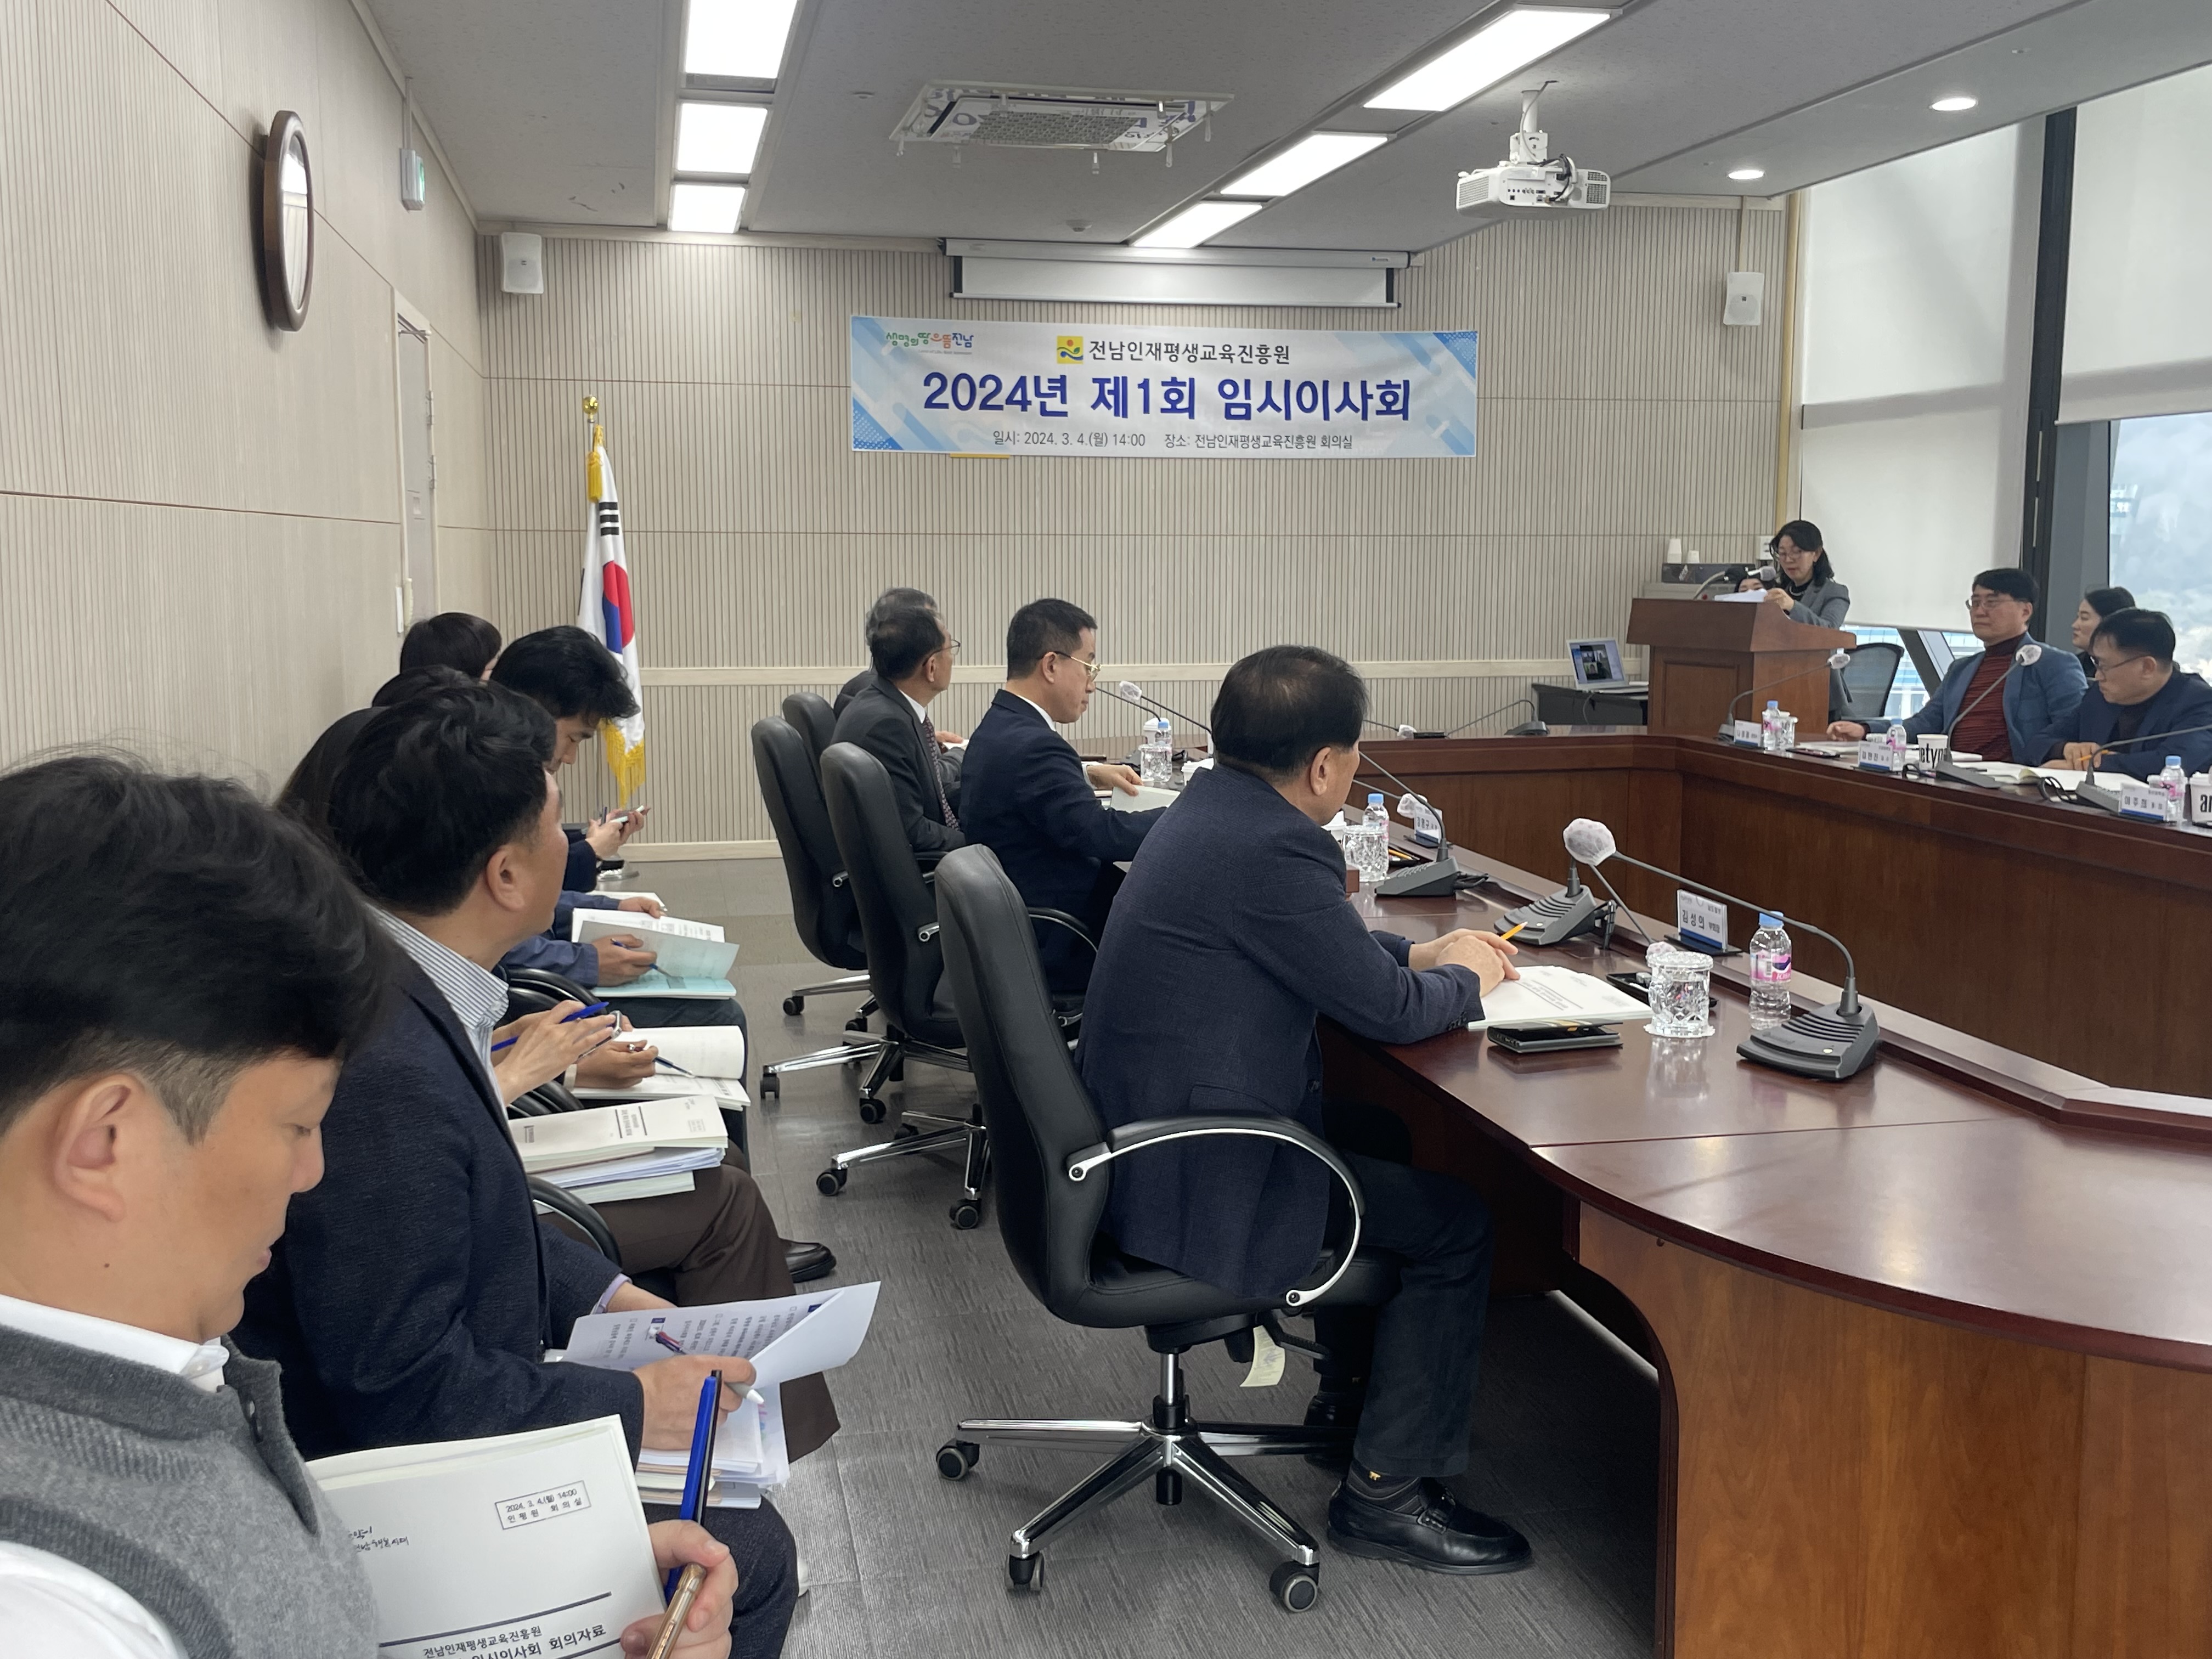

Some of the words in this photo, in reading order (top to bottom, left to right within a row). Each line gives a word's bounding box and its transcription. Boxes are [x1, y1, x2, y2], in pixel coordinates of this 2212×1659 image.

[1088, 341, 1290, 365] 전남인재평생교육진흥원
[923, 371, 1069, 417] 2024년
[1090, 375, 1195, 419] 제1회
[1217, 379, 1410, 421] 임시이사회
[993, 430, 1020, 445] 일시:
[1024, 432, 1058, 445] 2024.
[1062, 432, 1073, 445] 3.
[1113, 433, 1146, 447] 14:00
[1164, 434, 1190, 449] 장소:
[1194, 434, 1316, 449] 전남인재평생교육진흥원
[1320, 435, 1353, 449] 회의실
[506, 1502, 526, 1513] 2024.
[557, 1488, 577, 1499] 14:00
[424, 1626, 543, 1658] 전남인재평생교육진흥원
[549, 1624, 607, 1650] 회의자료
